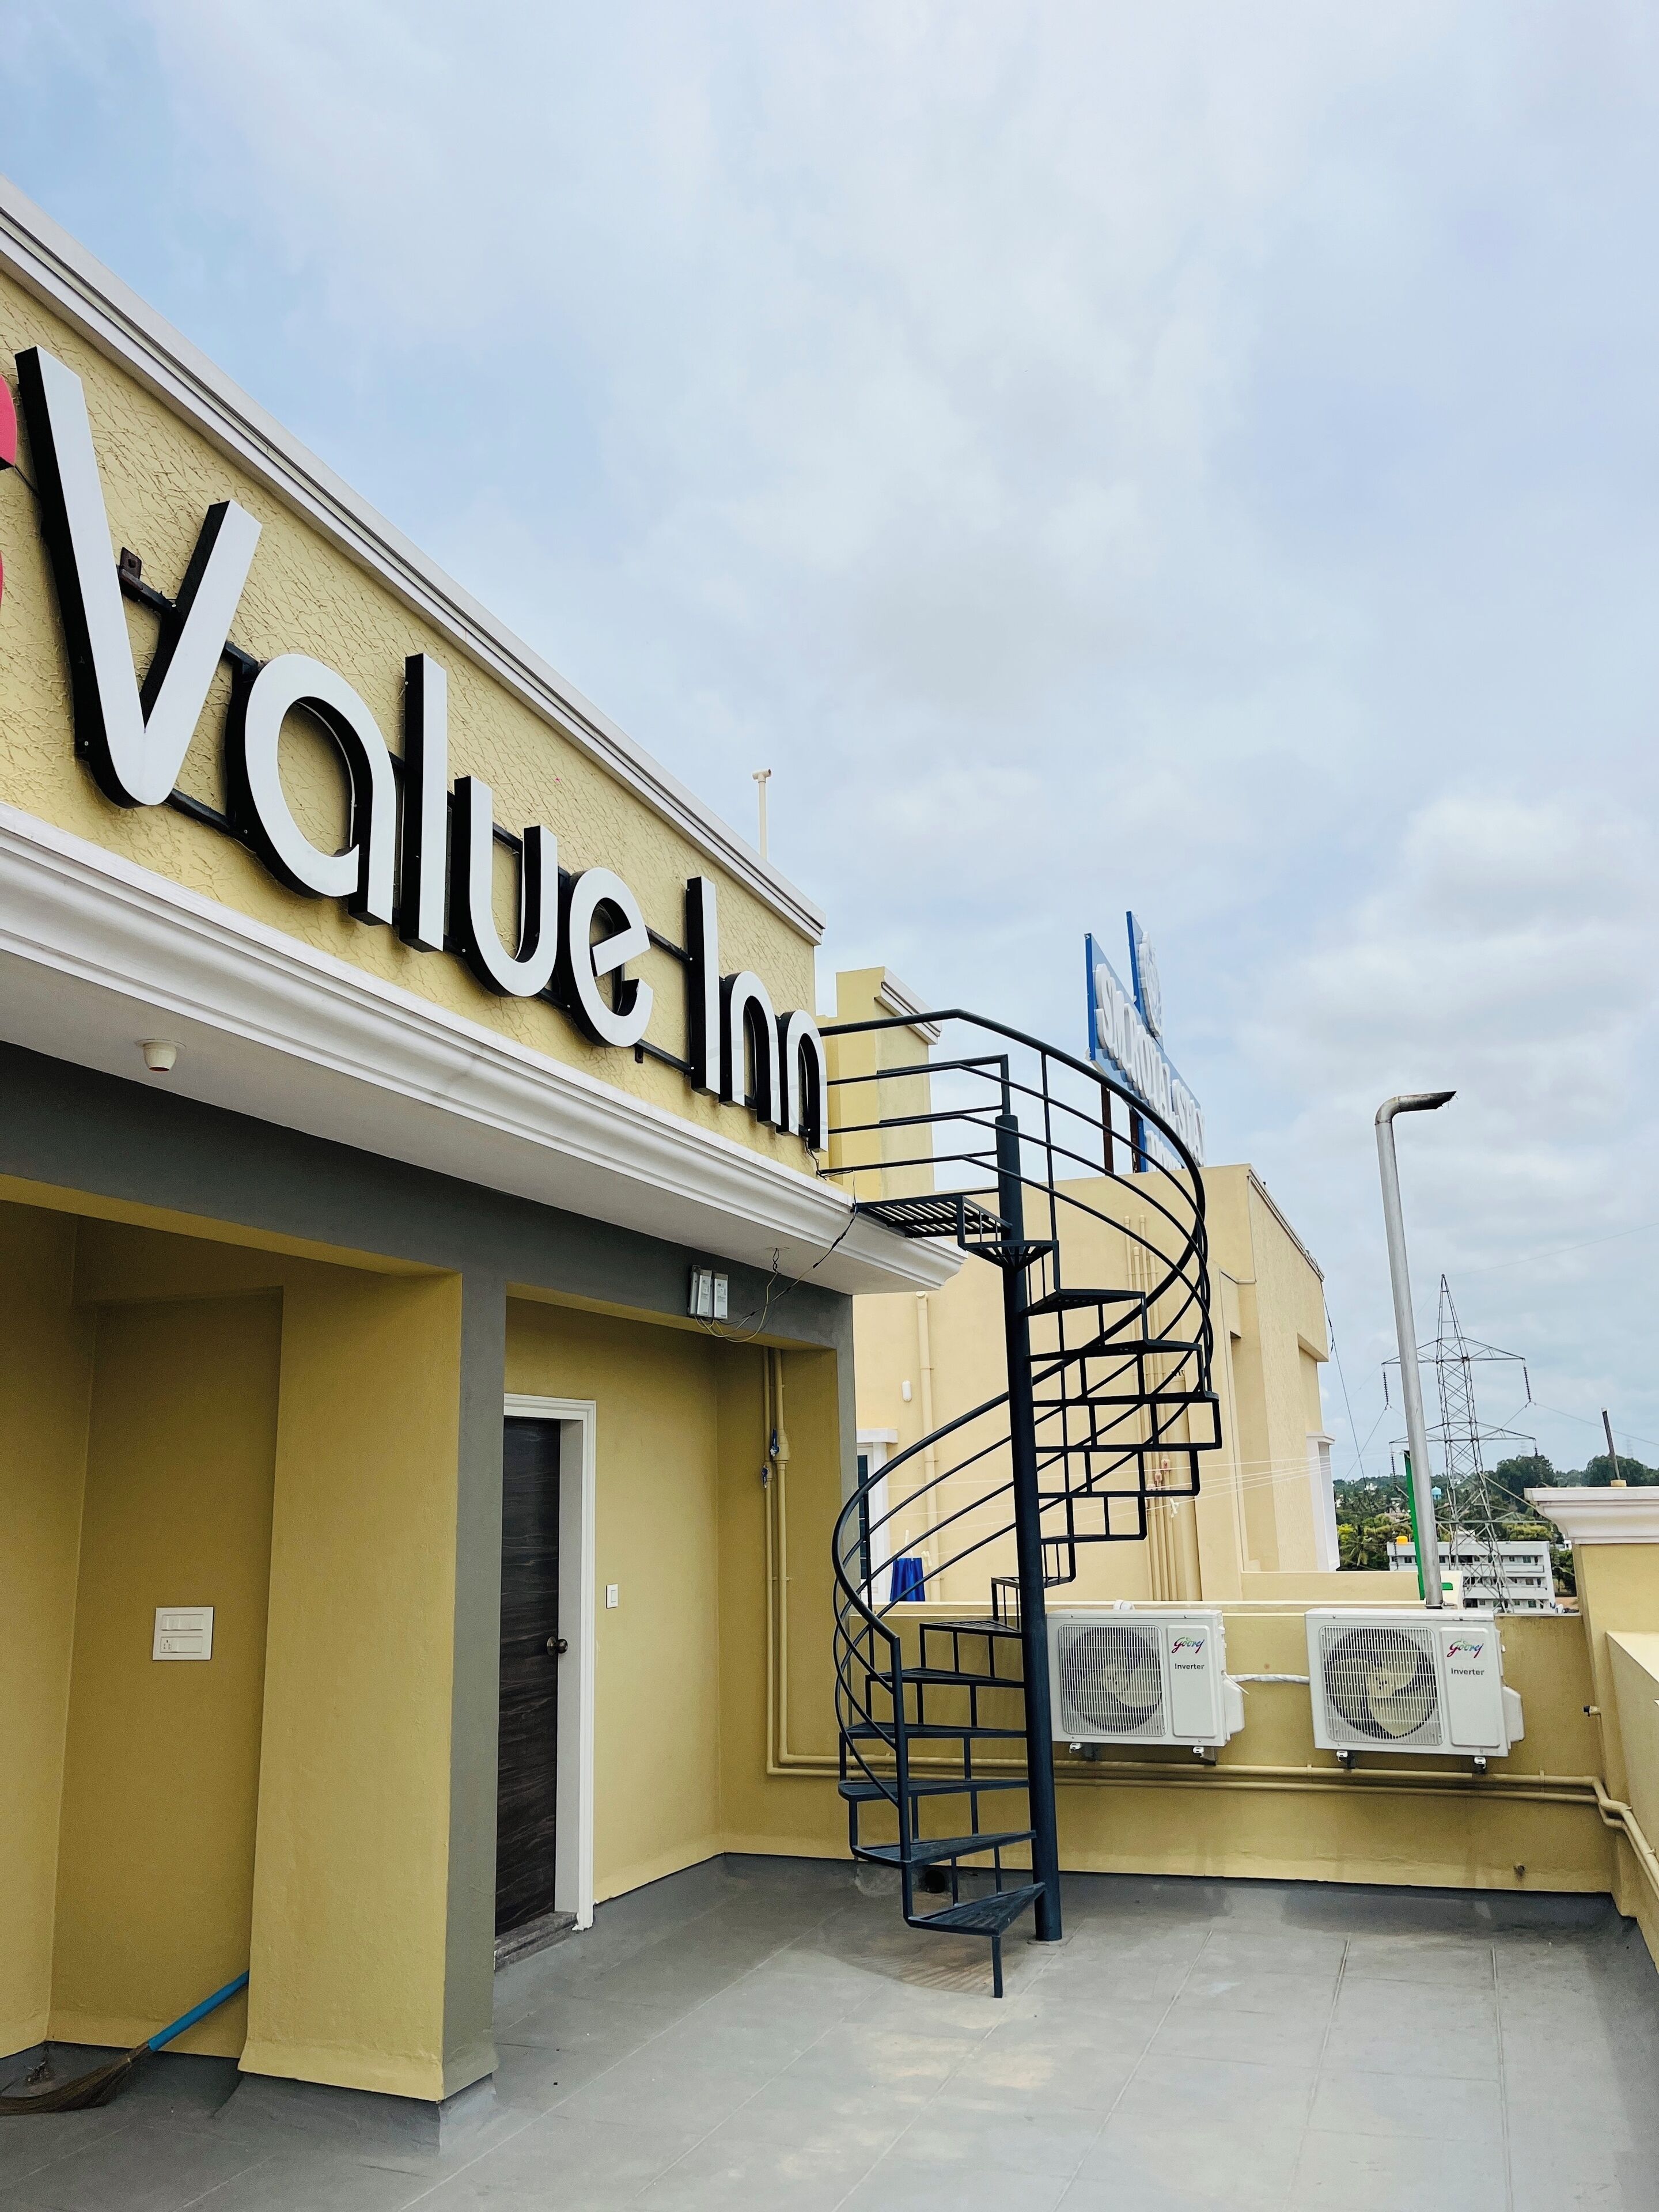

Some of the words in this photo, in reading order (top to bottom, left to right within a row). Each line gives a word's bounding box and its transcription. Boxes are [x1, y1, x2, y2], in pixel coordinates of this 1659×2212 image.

[28, 346, 652, 1047] Value
[694, 876, 828, 1152] Inn
[1451, 1668, 1484, 1676] Inverter
